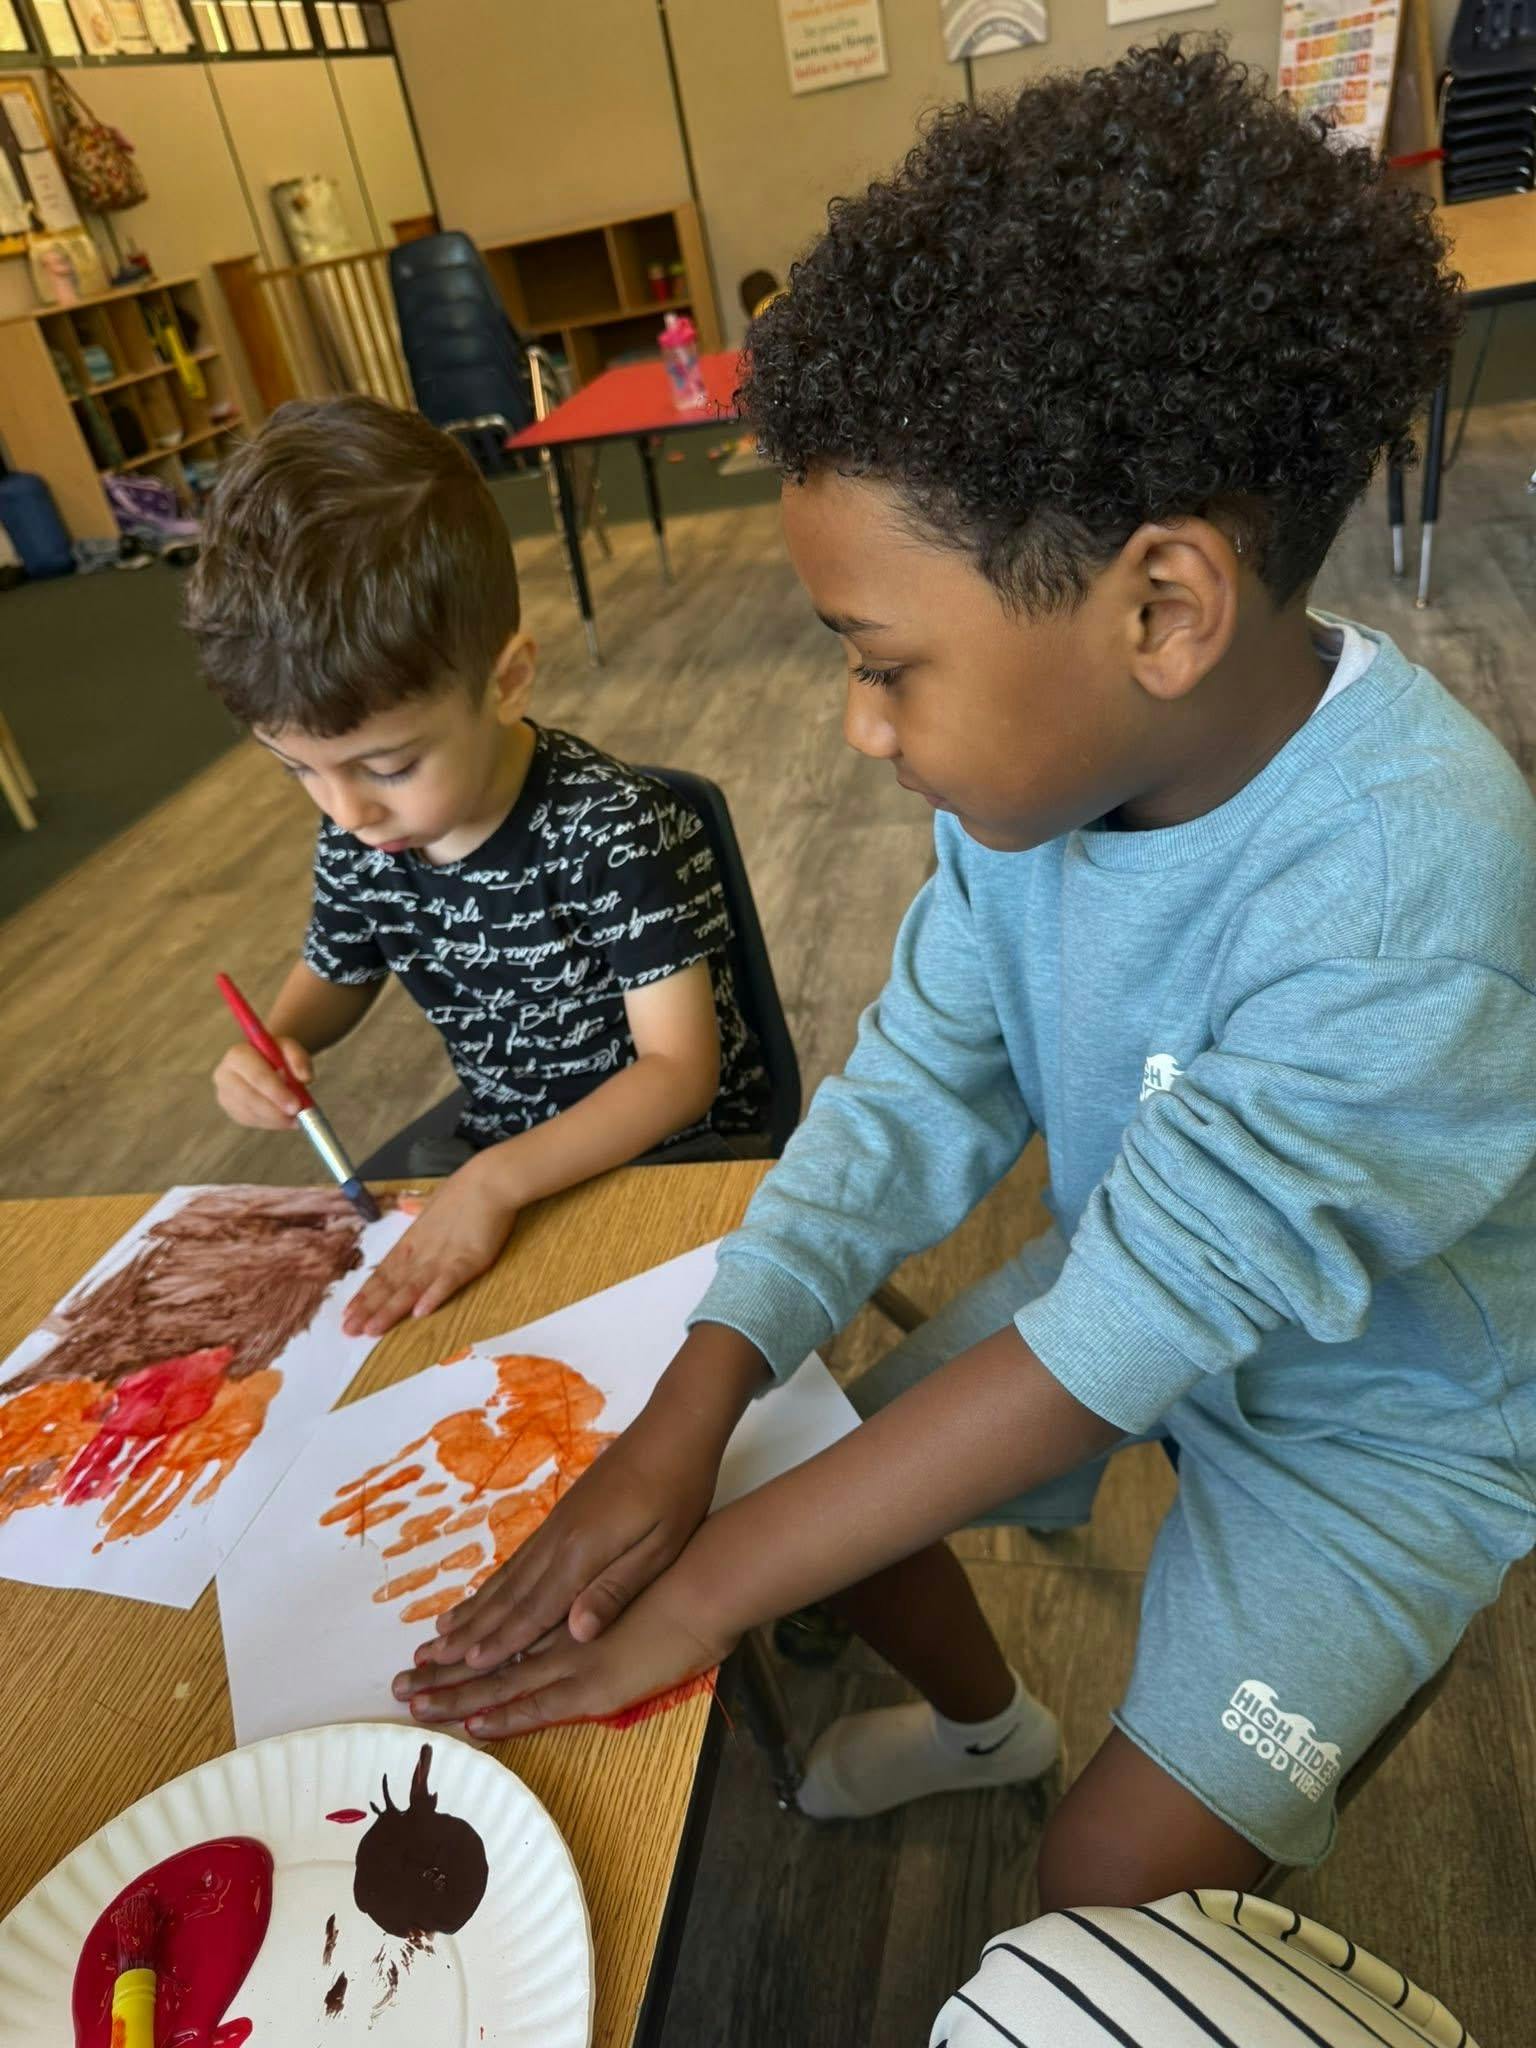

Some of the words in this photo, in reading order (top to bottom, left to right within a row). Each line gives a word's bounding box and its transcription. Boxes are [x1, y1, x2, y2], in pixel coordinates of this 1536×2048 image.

[1221, 1708, 1290, 1771] GOOD
[1235, 1687, 1293, 1744] HIGH
[1296, 1736, 1340, 1784] TIDES
